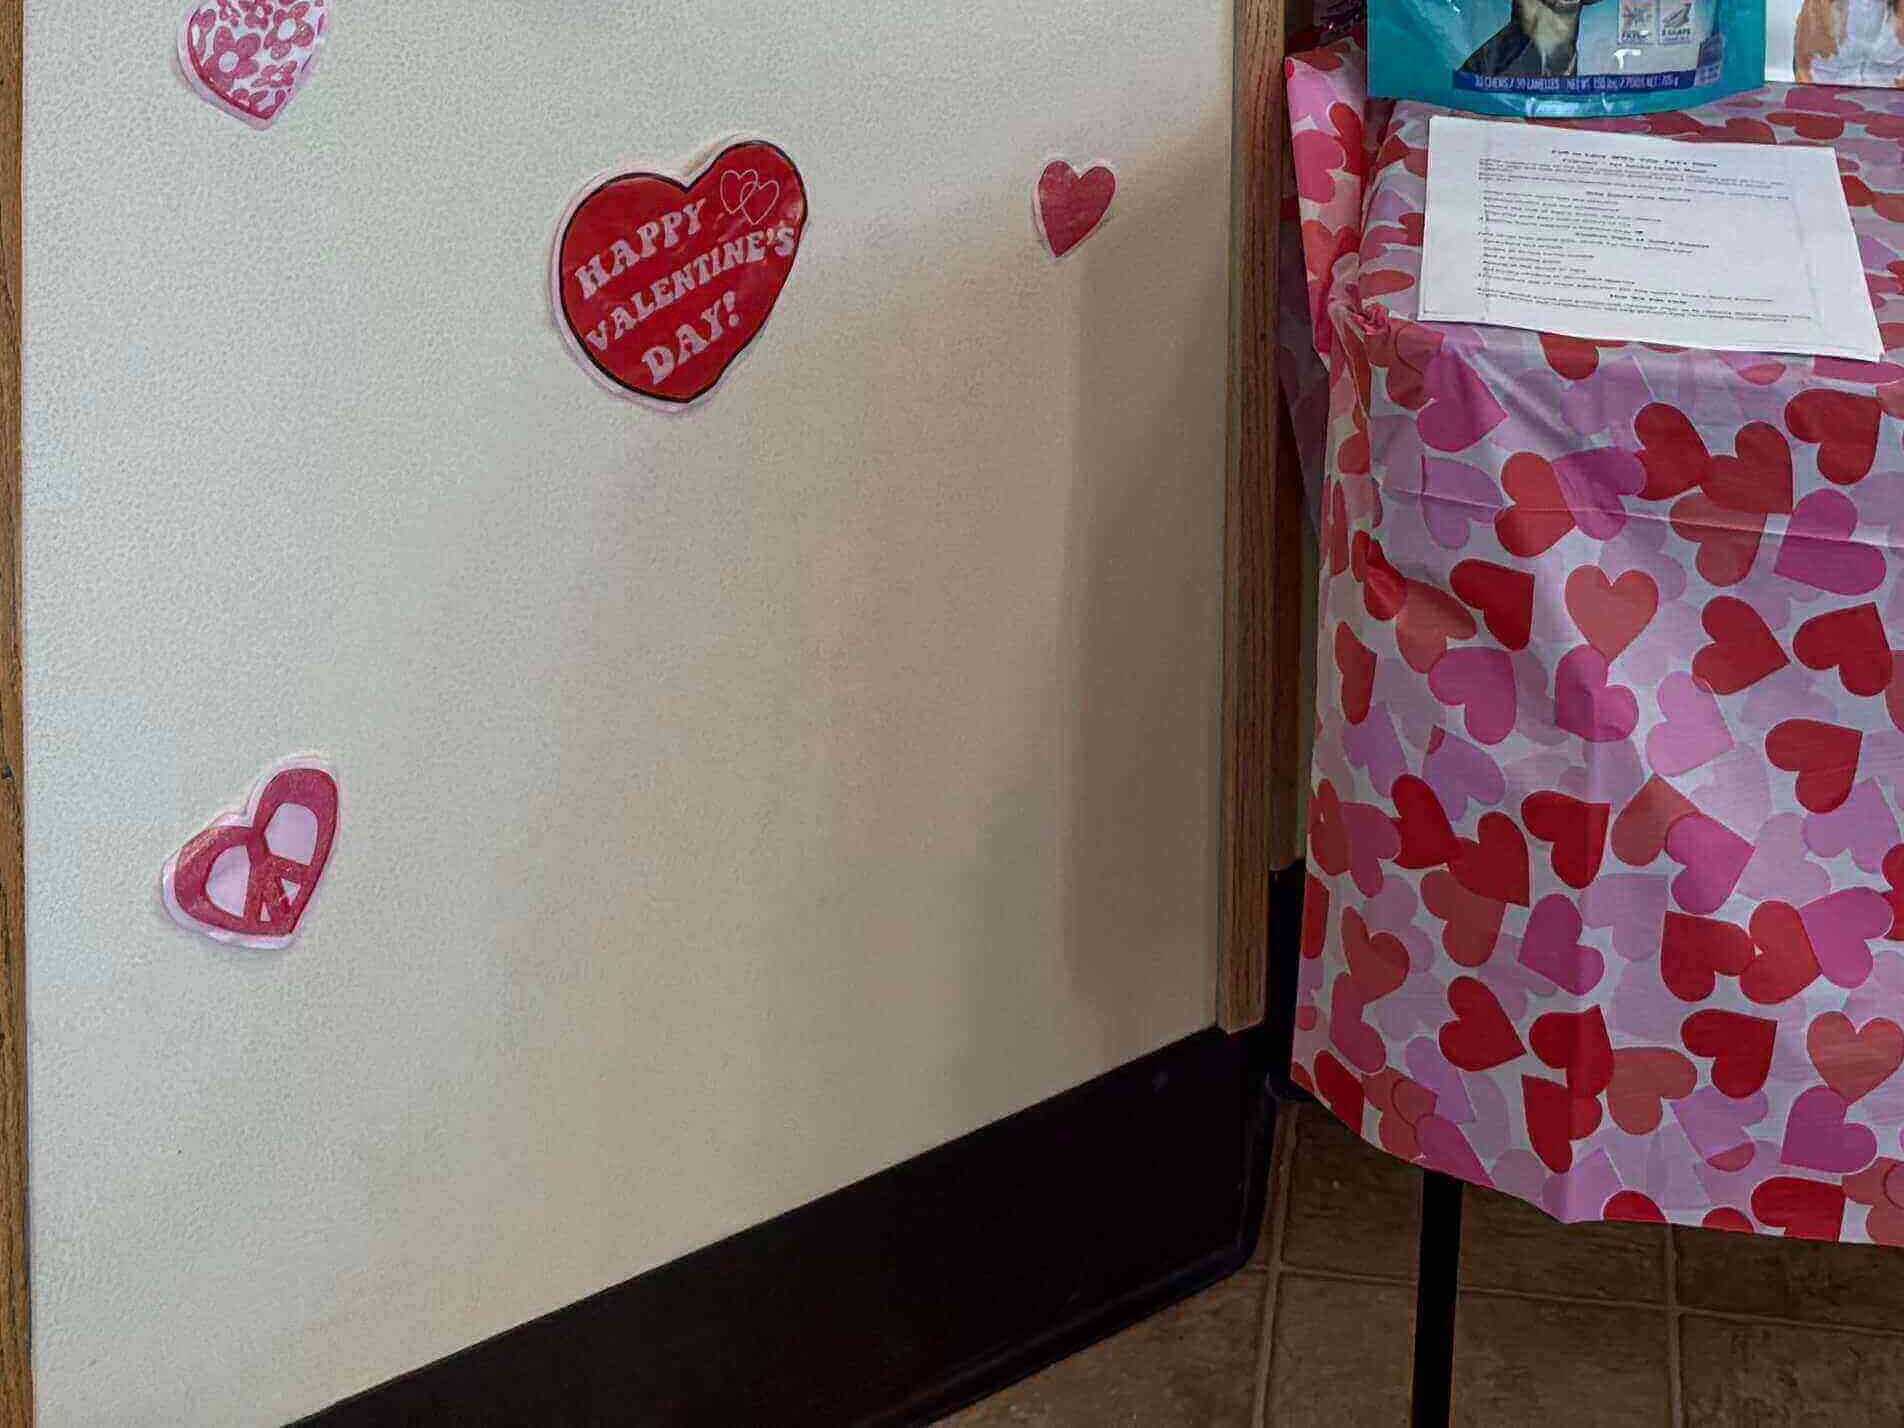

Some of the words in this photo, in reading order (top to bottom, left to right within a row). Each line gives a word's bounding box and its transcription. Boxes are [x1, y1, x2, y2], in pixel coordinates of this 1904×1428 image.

[574, 198, 706, 300] HAPPY
[586, 225, 795, 352] VALENTINE'S
[642, 290, 742, 385] DAY!
